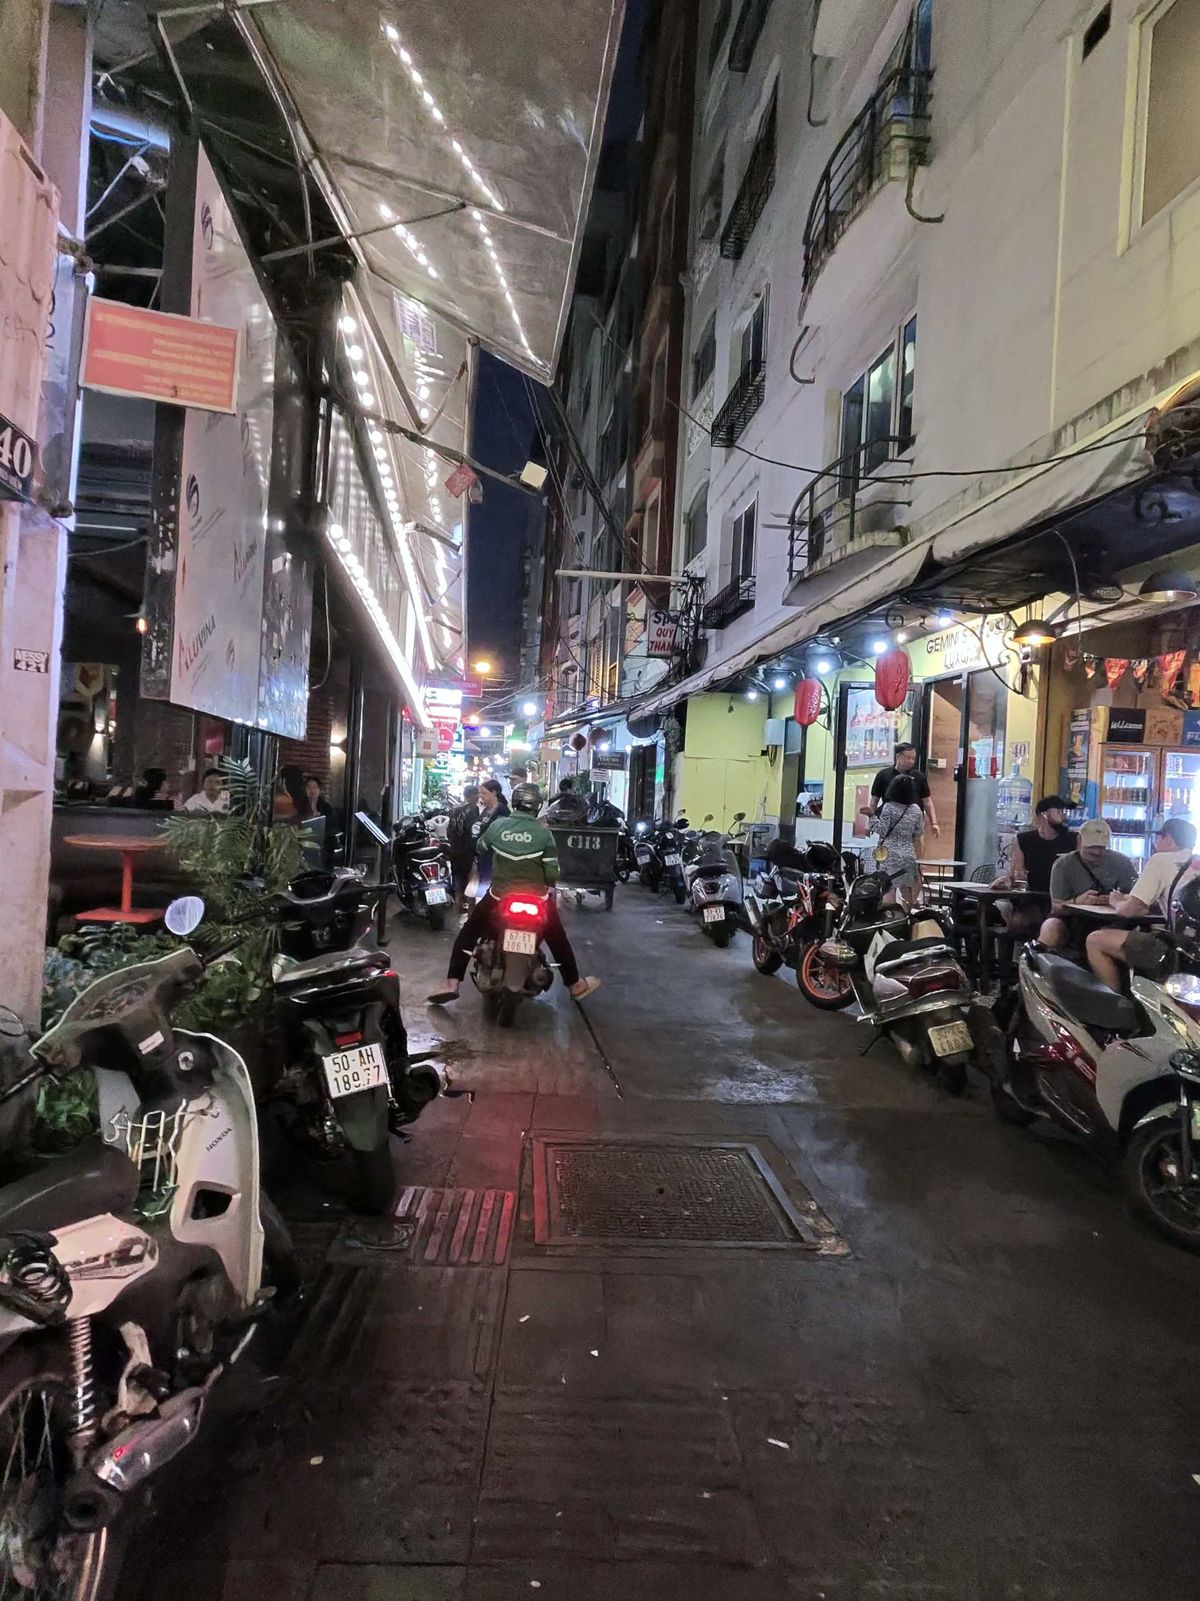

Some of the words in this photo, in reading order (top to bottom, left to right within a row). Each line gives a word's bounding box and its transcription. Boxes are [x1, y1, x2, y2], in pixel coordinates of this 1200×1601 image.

[501, 830, 532, 843] Grab
[332, 1047, 375, 1073] 50-AH
[206, 1127, 232, 1151] HONDA
